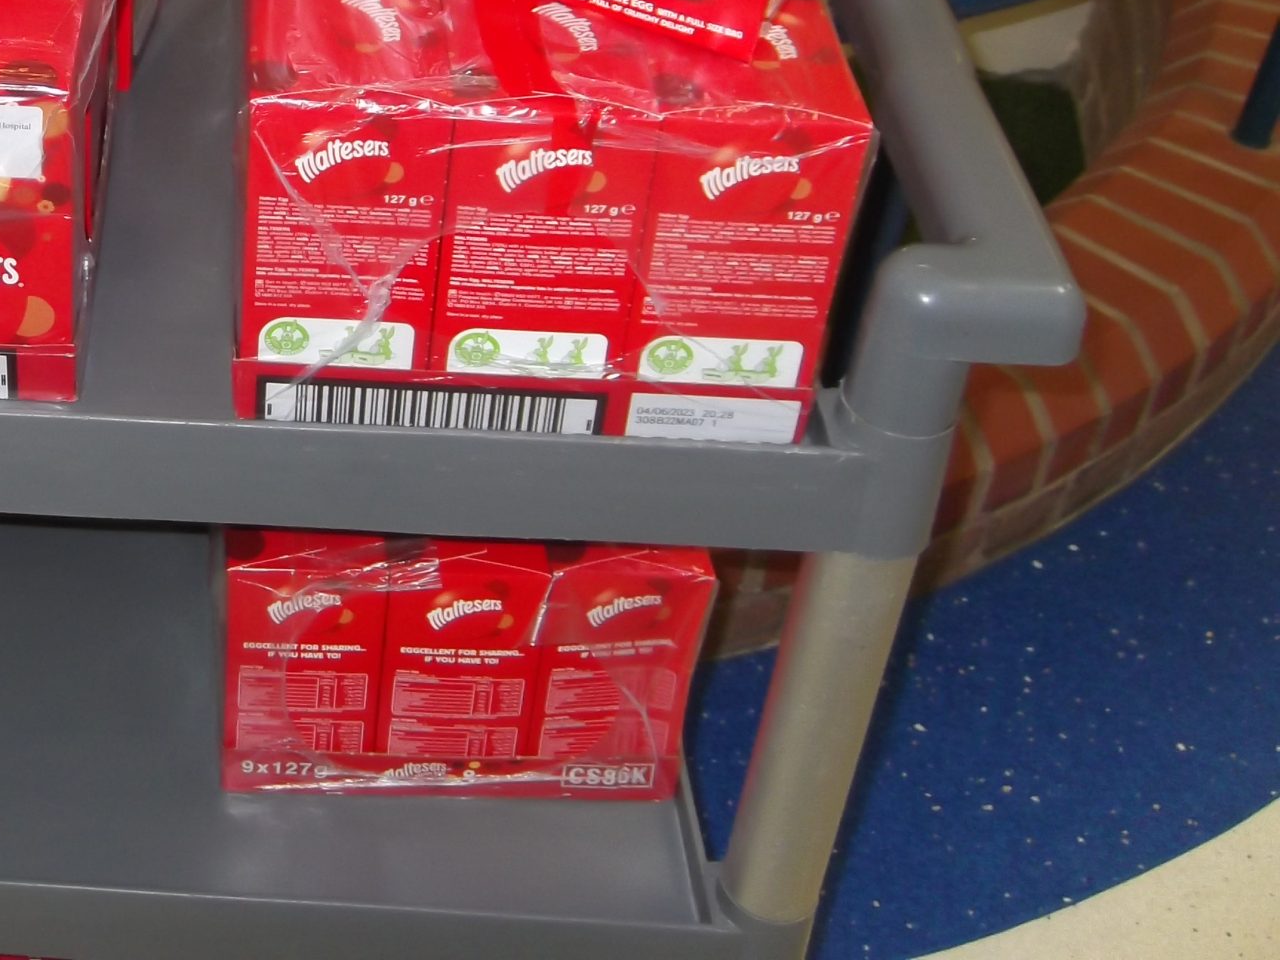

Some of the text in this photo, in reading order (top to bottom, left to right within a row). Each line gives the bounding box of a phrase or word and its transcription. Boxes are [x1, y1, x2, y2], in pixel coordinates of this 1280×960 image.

[531, 2, 598, 53] Maltesers
[680, 14, 685, 22] A
[686, 16, 705, 28] FULL
[295, 139, 389, 183] Maltesers
[496, 147, 593, 192] Maltesers
[699, 155, 800, 200] Maltesers
[384, 194, 417, 206] 127 g
[584, 204, 618, 216] 127 g
[787, 211, 823, 223] 127 g
[267, 592, 341, 625] Maltesers
[427, 599, 502, 630] Maltesers
[587, 595, 662, 627] Maltesers
[243, 642, 298, 650] EGGCELLENT
[400, 647, 456, 655] EGGCELLENT
